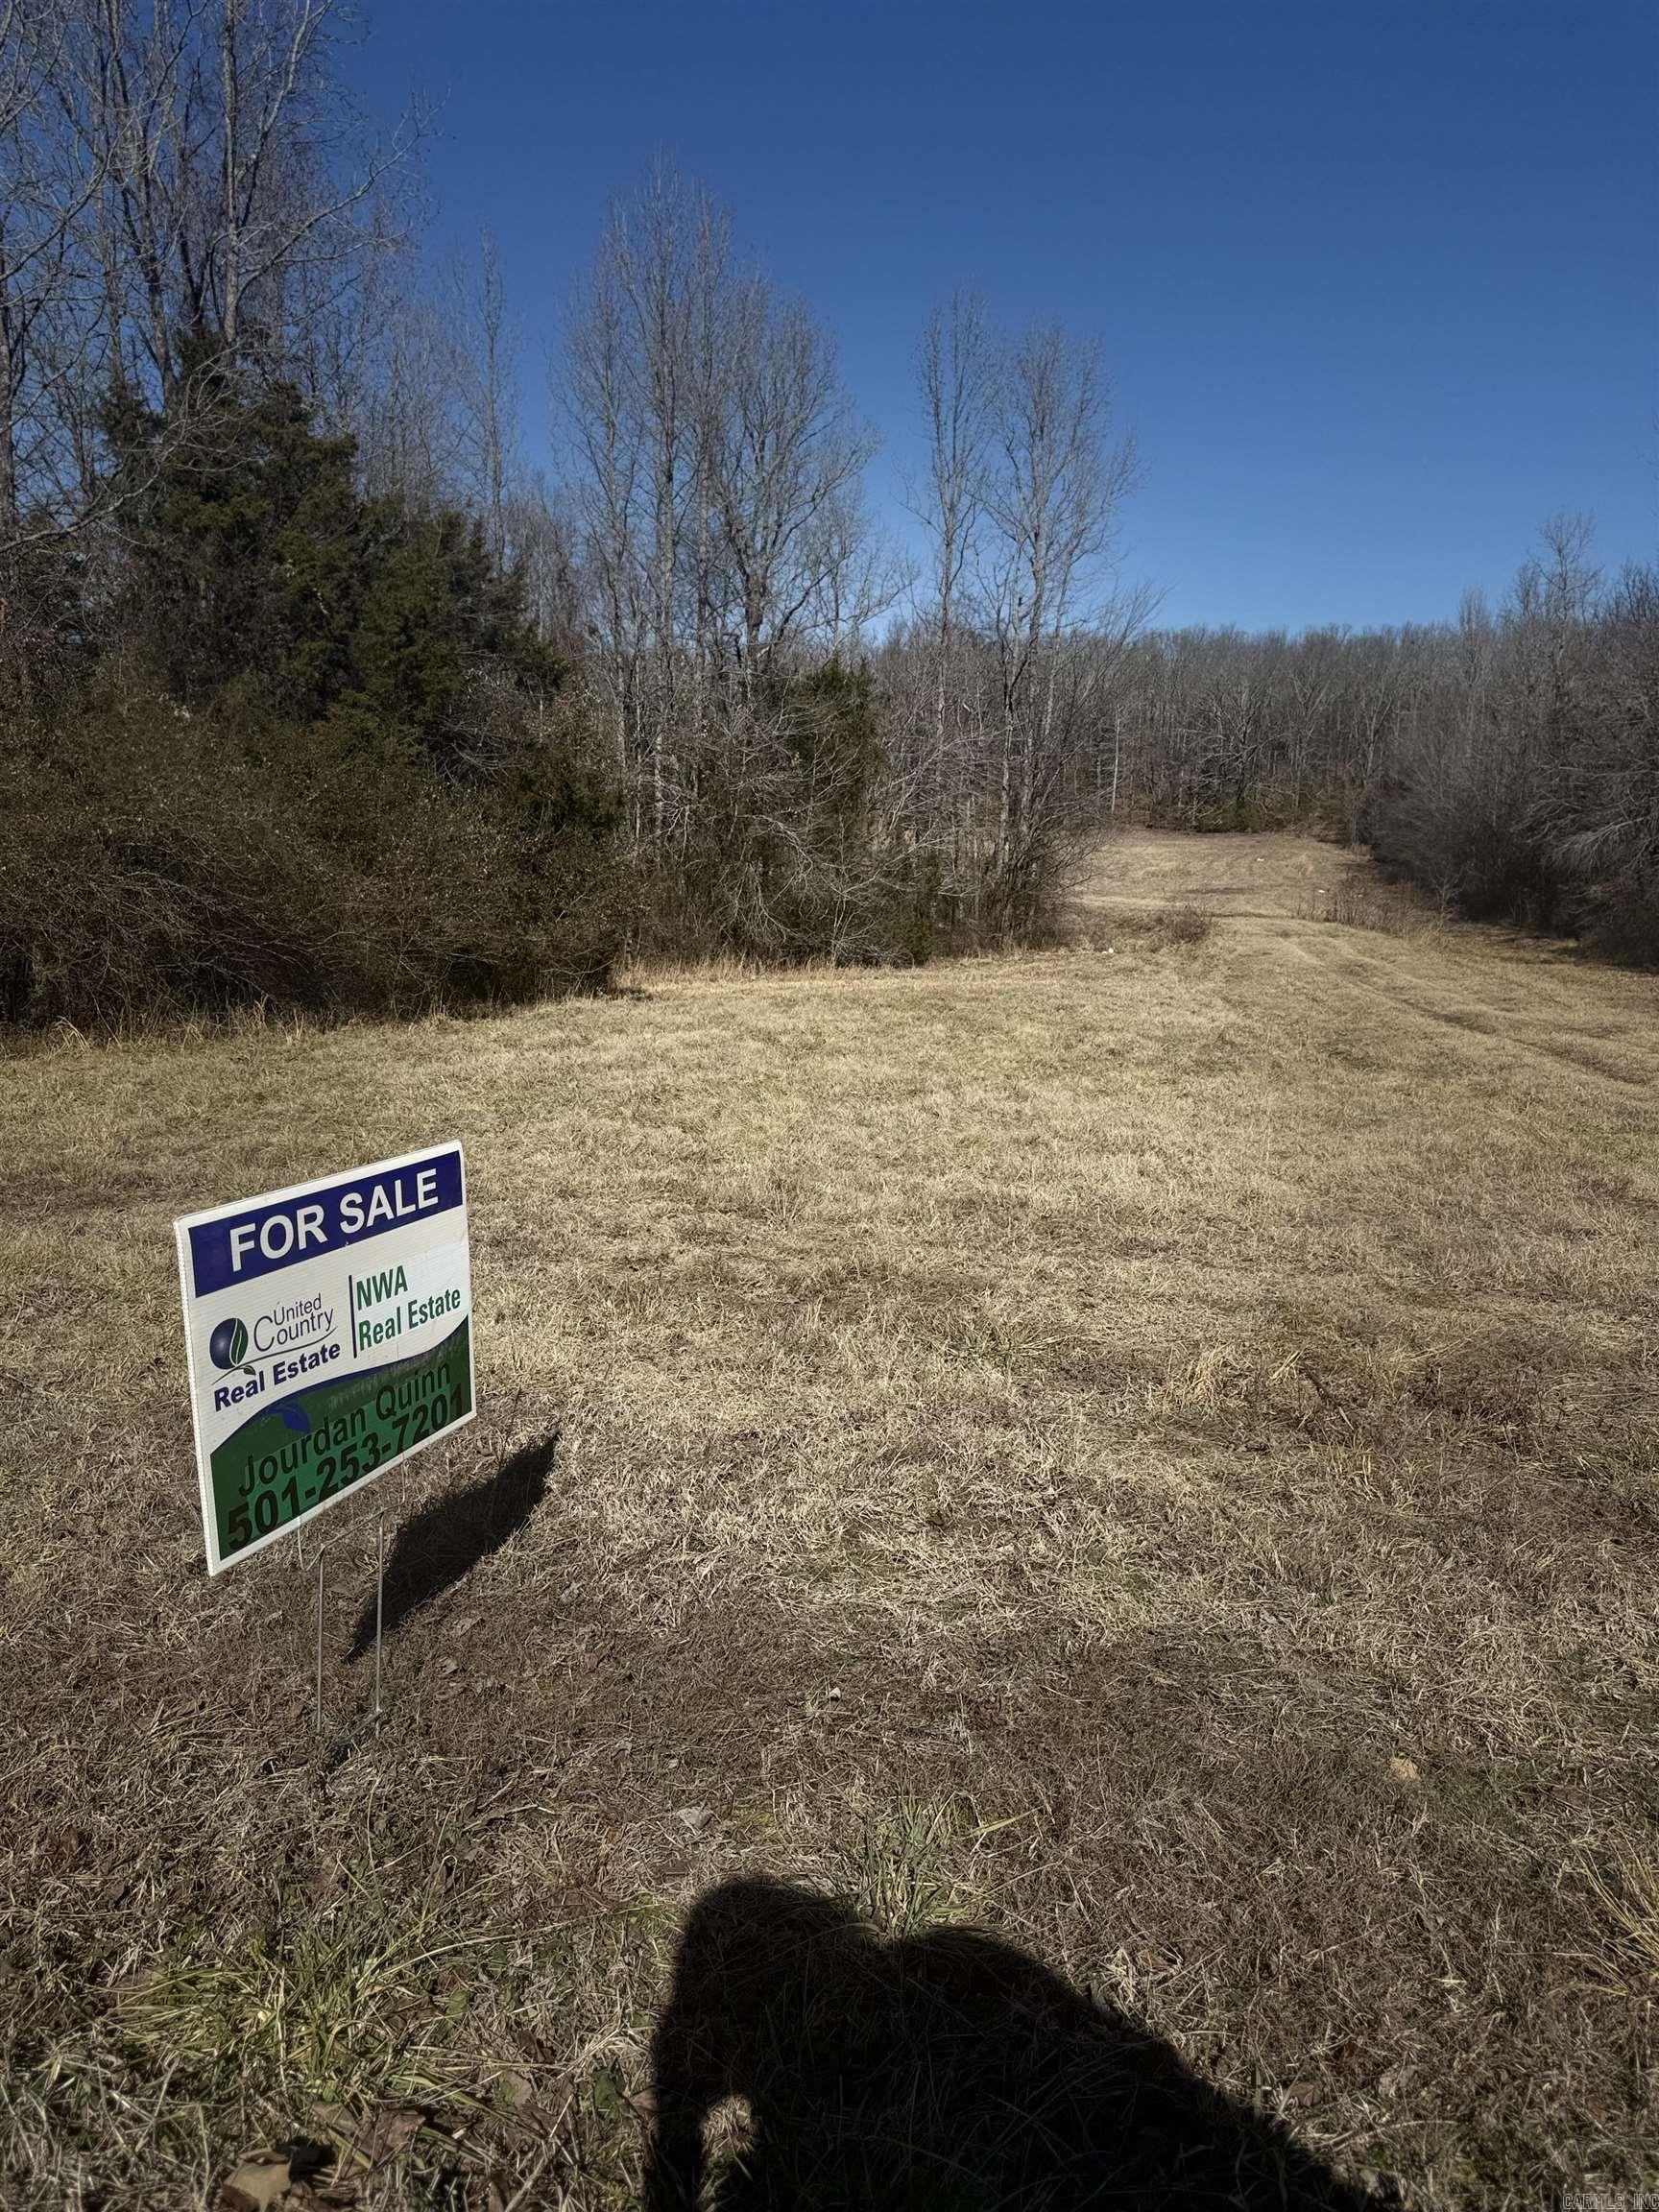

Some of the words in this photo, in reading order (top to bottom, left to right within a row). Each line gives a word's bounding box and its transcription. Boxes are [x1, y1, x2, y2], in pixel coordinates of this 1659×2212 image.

[229, 1204, 327, 1272] FOR
[339, 1167, 439, 1235] SALE
[274, 1292, 322, 1327] United
[355, 1265, 408, 1310] NWA
[358, 1307, 402, 1351] Real
[408, 1286, 462, 1331] Estate
[253, 1308, 334, 1352] Country
[214, 1369, 266, 1411] Real
[273, 1341, 342, 1387] Estate
[238, 1406, 367, 1498] Jourdan
[375, 1362, 451, 1420] Quinn
[227, 1382, 466, 1551] 501-253-7201
